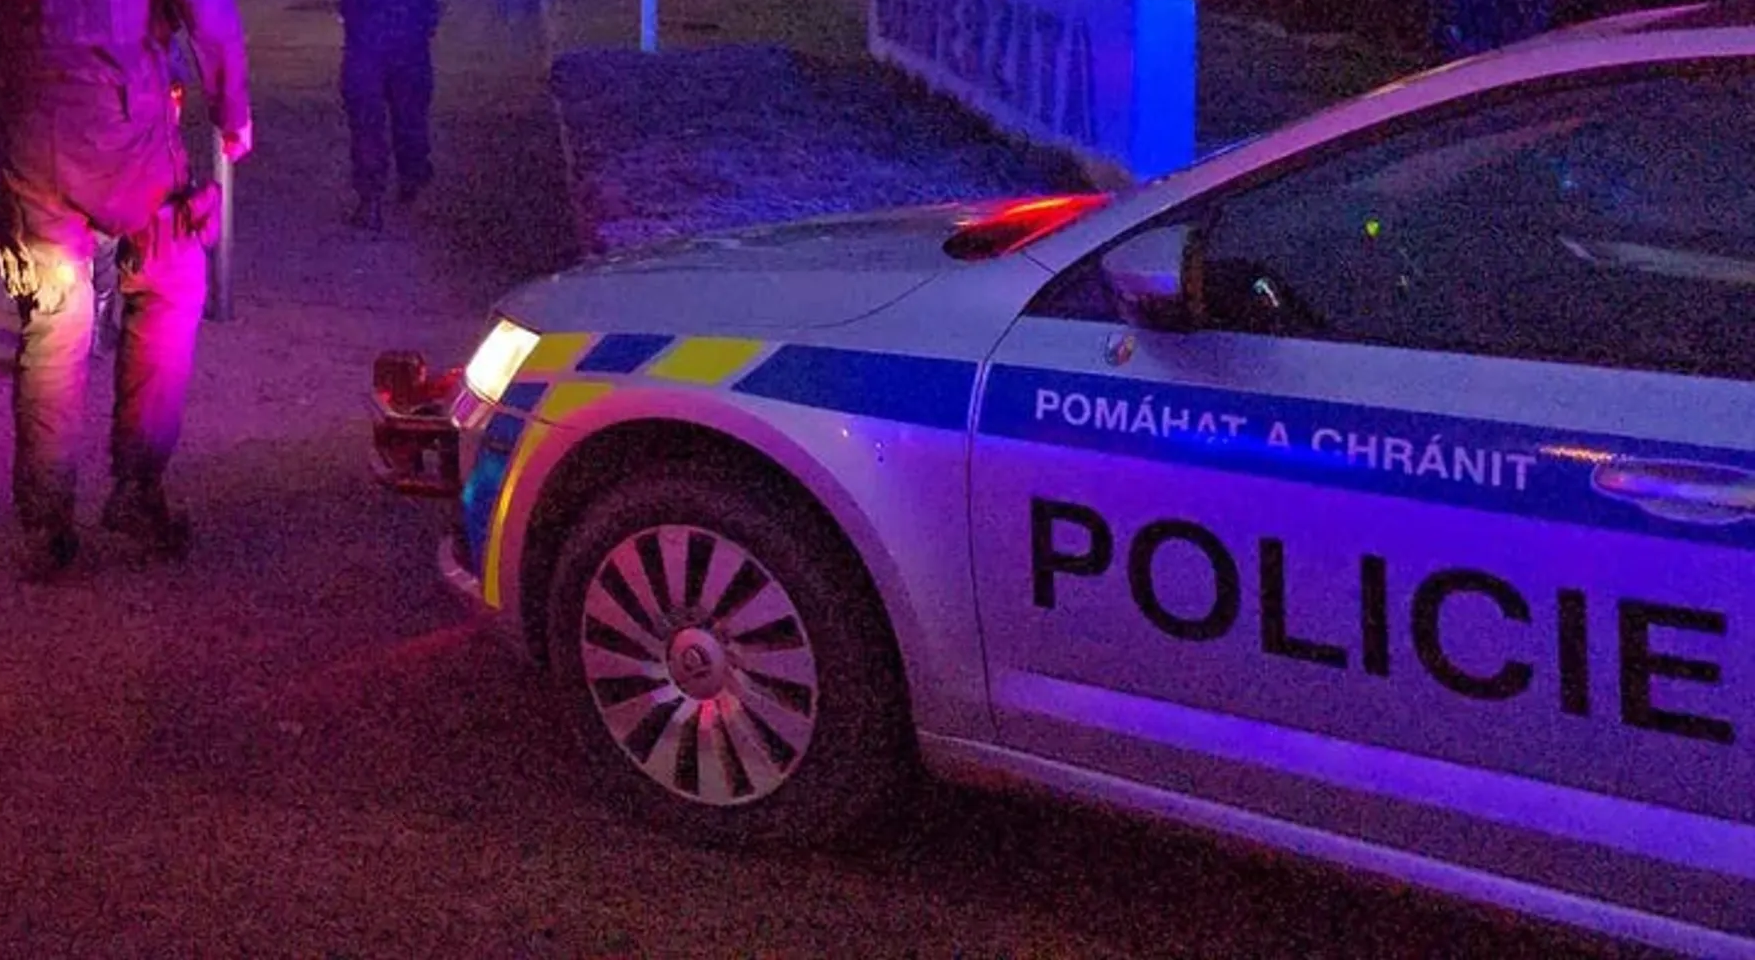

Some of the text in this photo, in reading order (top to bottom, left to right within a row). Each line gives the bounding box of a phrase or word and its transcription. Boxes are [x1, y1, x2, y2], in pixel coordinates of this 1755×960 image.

[1035, 388, 1537, 491] POMÁHAT A CHRÁNIT
[1030, 497, 1736, 746] POLICIE
